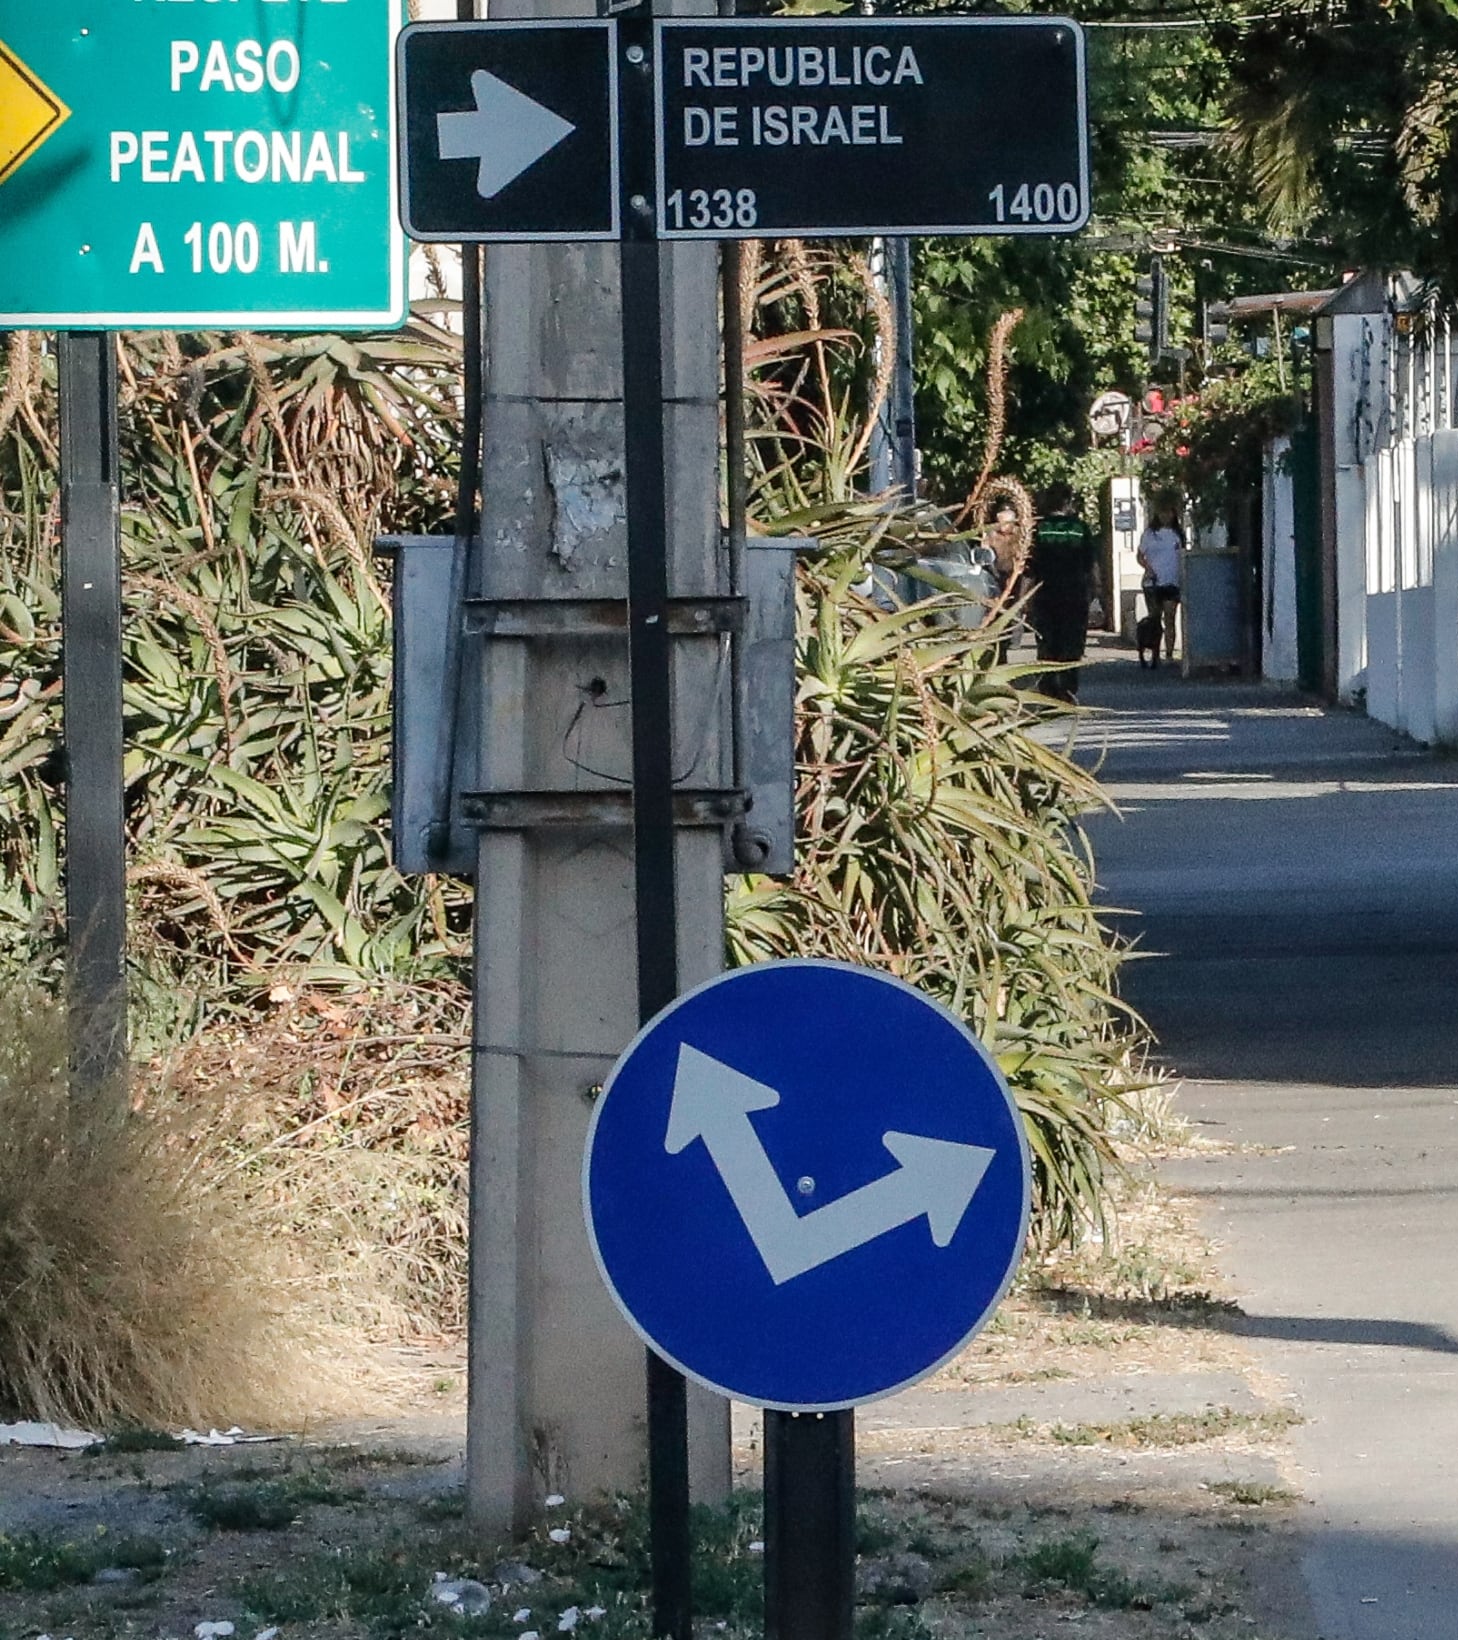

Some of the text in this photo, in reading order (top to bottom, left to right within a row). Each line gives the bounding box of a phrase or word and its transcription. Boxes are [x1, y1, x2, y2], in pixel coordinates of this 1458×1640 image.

[171, 39, 300, 92] PASO
[683, 46, 924, 87] REPUBLICA
[683, 105, 903, 146] DE ISRAEL
[110, 130, 366, 183] PEATONAL
[667, 188, 757, 228] 1338
[988, 183, 1077, 222] 1400
[129, 221, 329, 273] A 100 M.
